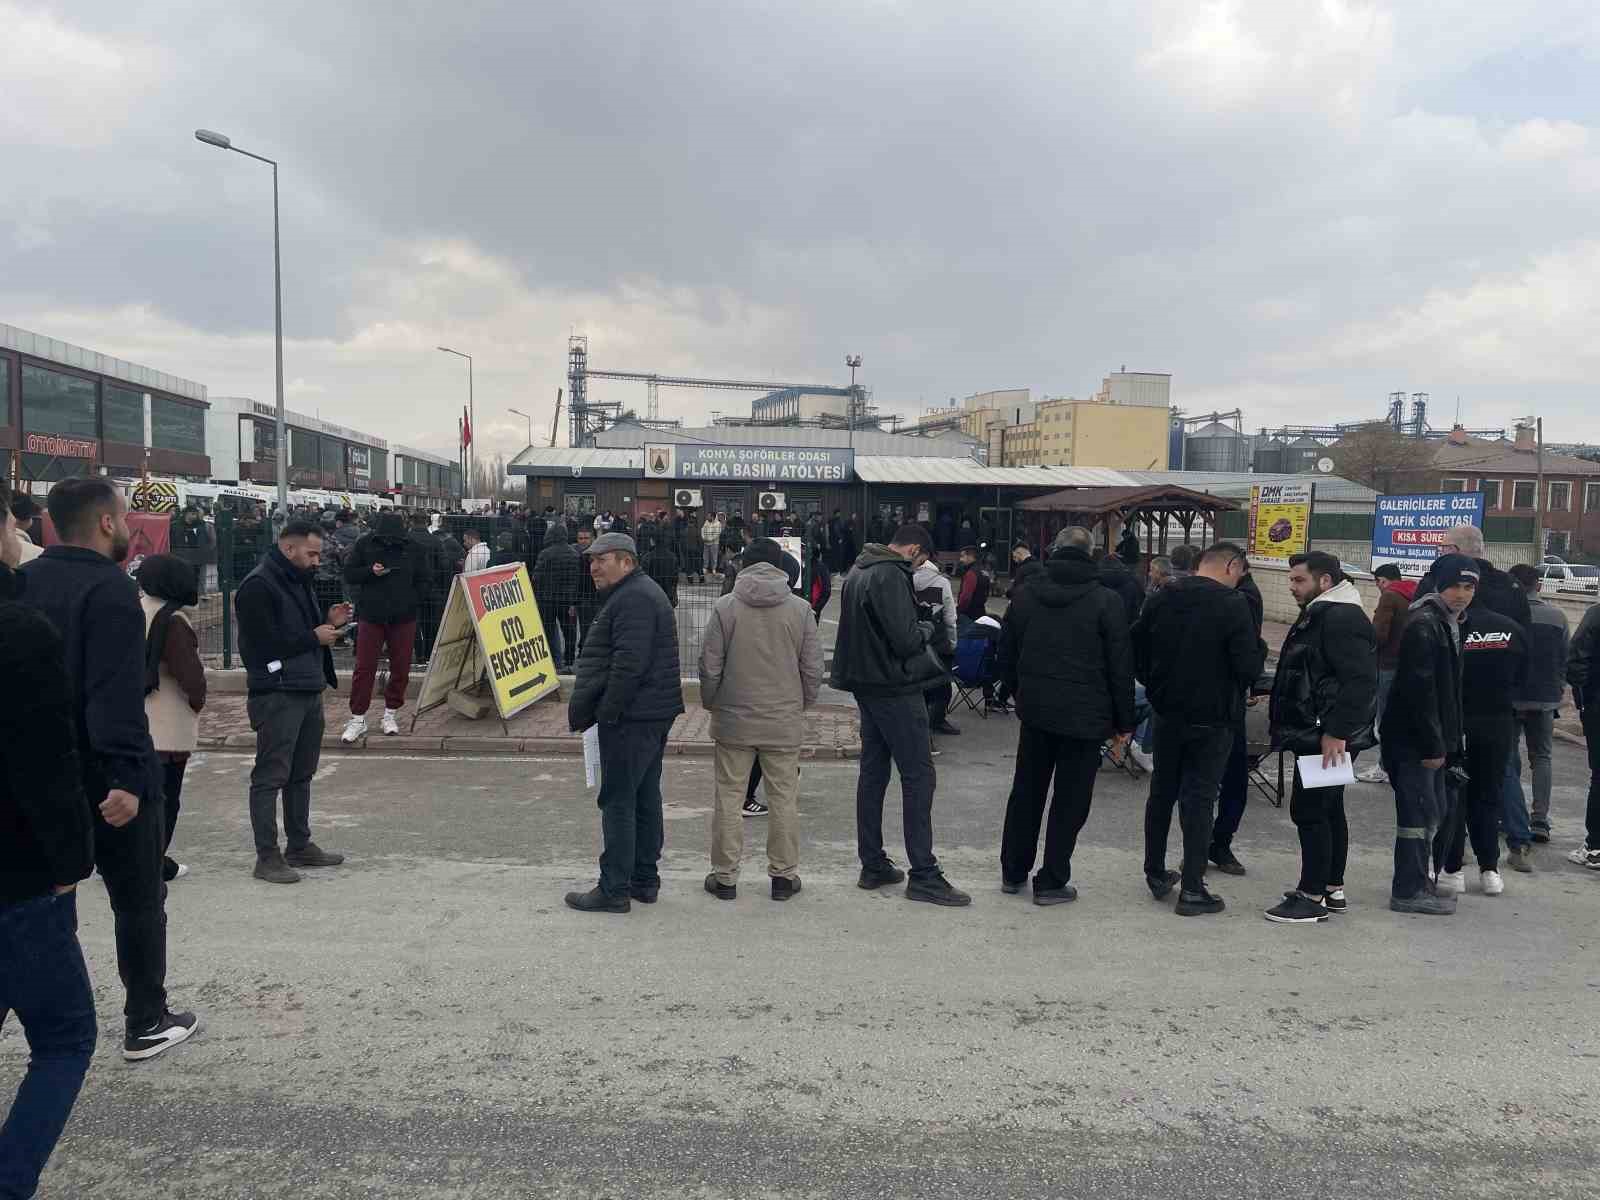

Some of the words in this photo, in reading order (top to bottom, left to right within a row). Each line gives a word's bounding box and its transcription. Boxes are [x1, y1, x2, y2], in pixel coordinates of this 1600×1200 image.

[698, 449, 736, 459] KONYA
[739, 448, 795, 461] ŞOFÖRLER
[798, 451, 830, 461] ODASI
[682, 462, 729, 477] PLAKA
[733, 463, 777, 478] BASIM
[780, 462, 846, 479] ATÖLYESİ
[1261, 486, 1283, 497] DMK
[1380, 497, 1446, 511] GALERİCİLERE
[1451, 496, 1478, 510] ÖZEL
[1382, 513, 1415, 526] TRAFİK
[1419, 514, 1473, 528] SİGORTASI
[1397, 532, 1417, 543] KISA
[1408, 548, 1436, 557] BAŞLAYAN
[480, 574, 526, 612] GARANTİ
[500, 616, 525, 645] OTO
[489, 634, 549, 681] EKSPERTİZ
